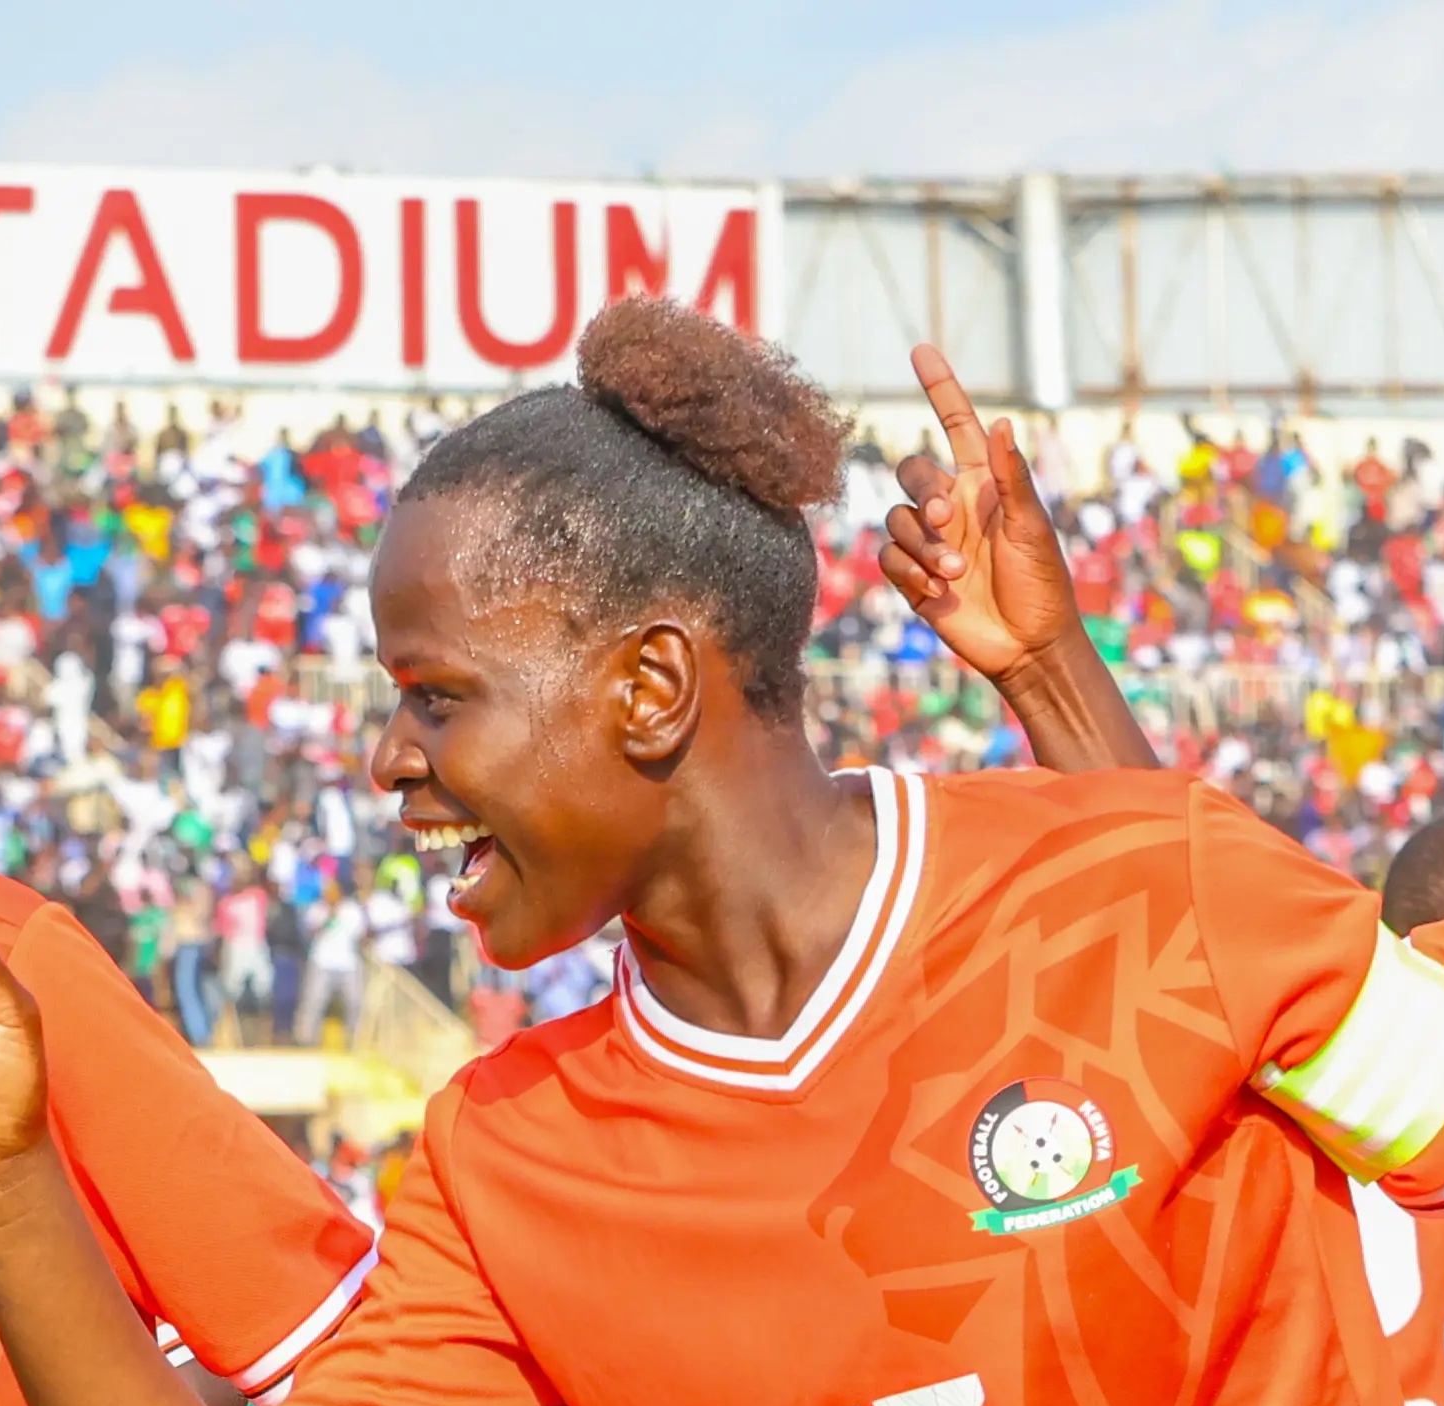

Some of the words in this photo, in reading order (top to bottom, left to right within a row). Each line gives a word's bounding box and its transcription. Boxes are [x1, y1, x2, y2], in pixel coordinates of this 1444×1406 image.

[973, 1112, 1008, 1204] FOOTBALL
[1078, 1099, 1112, 1161] KENYA
[1003, 1187, 1116, 1232] FEDERATION
